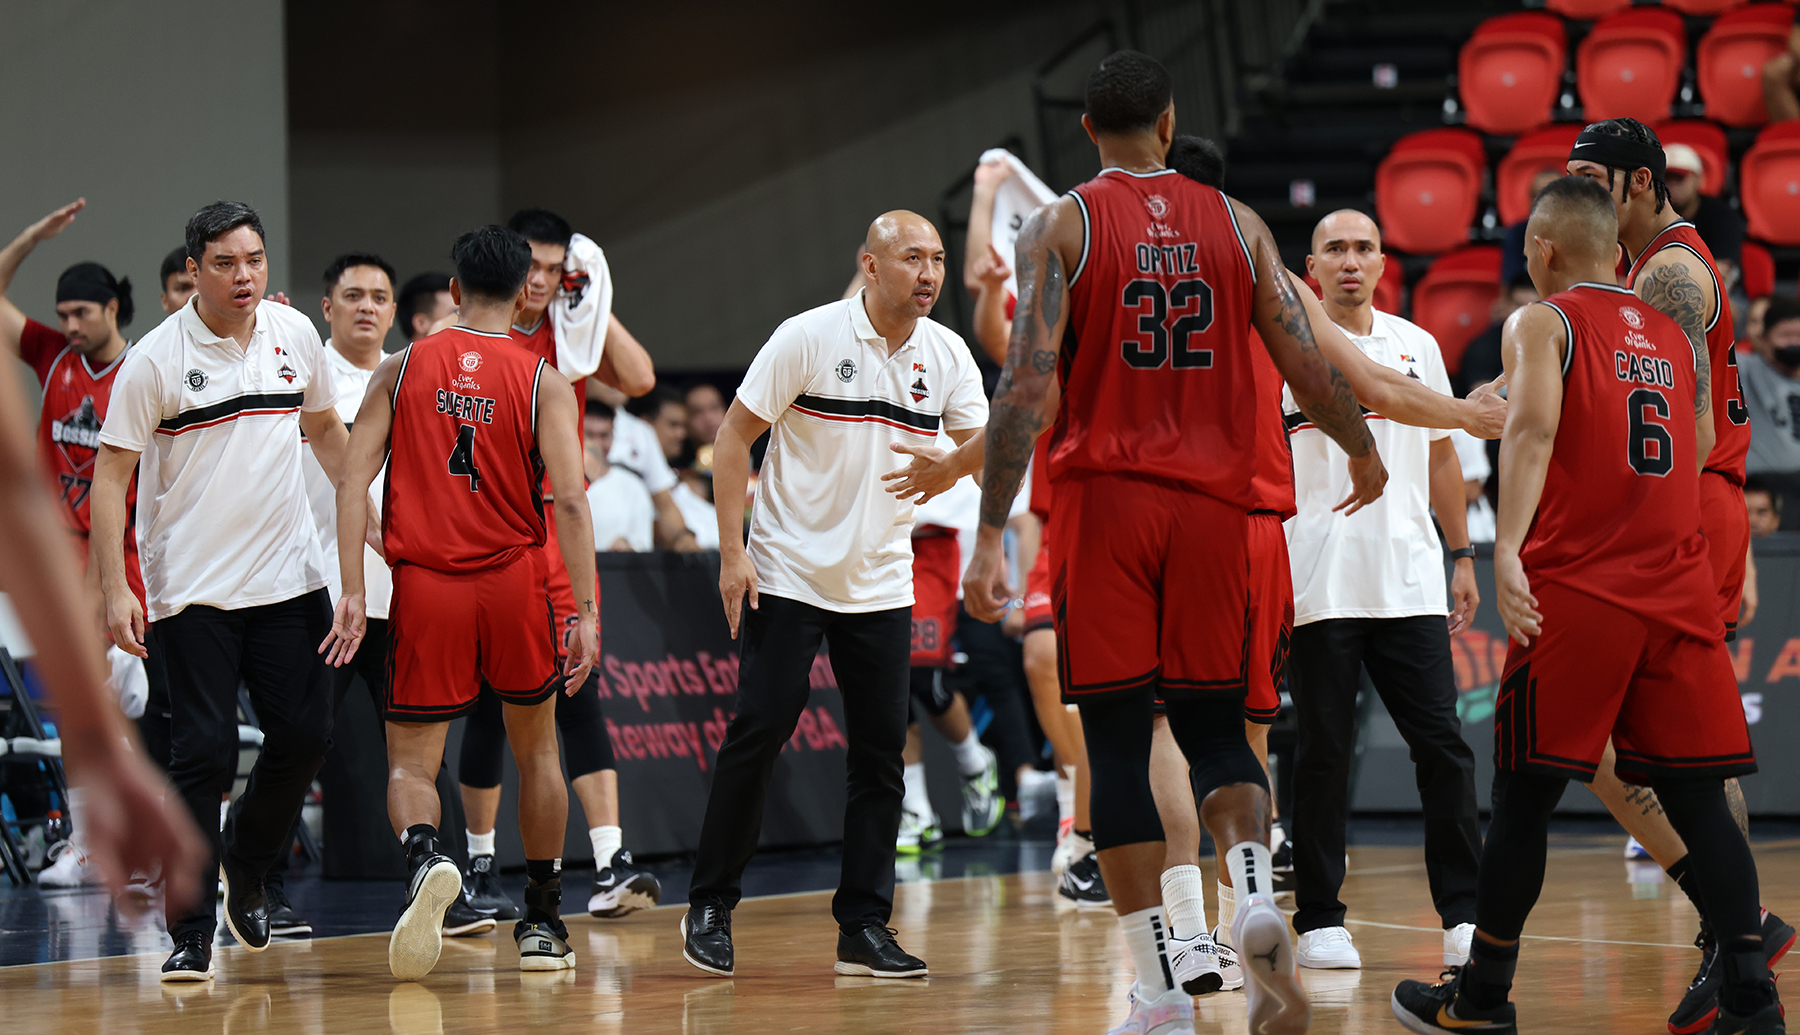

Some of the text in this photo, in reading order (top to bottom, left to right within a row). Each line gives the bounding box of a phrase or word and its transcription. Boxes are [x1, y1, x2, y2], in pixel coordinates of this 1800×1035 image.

[1136, 242, 1199, 274] ORTIZ
[1121, 278, 1213, 369] 32
[1628, 330, 1645, 342] Ever
[452, 378, 481, 391] Organics
[458, 373, 474, 383] Ever
[1614, 349, 1675, 390] CASIO
[436, 387, 496, 424] SUERTE
[51, 419, 101, 449] BOSSI
[1626, 387, 1674, 478] 6
[447, 423, 482, 493] 4
[59, 473, 95, 511] 77
[604, 653, 707, 713] Sports
[604, 717, 708, 772] teway
